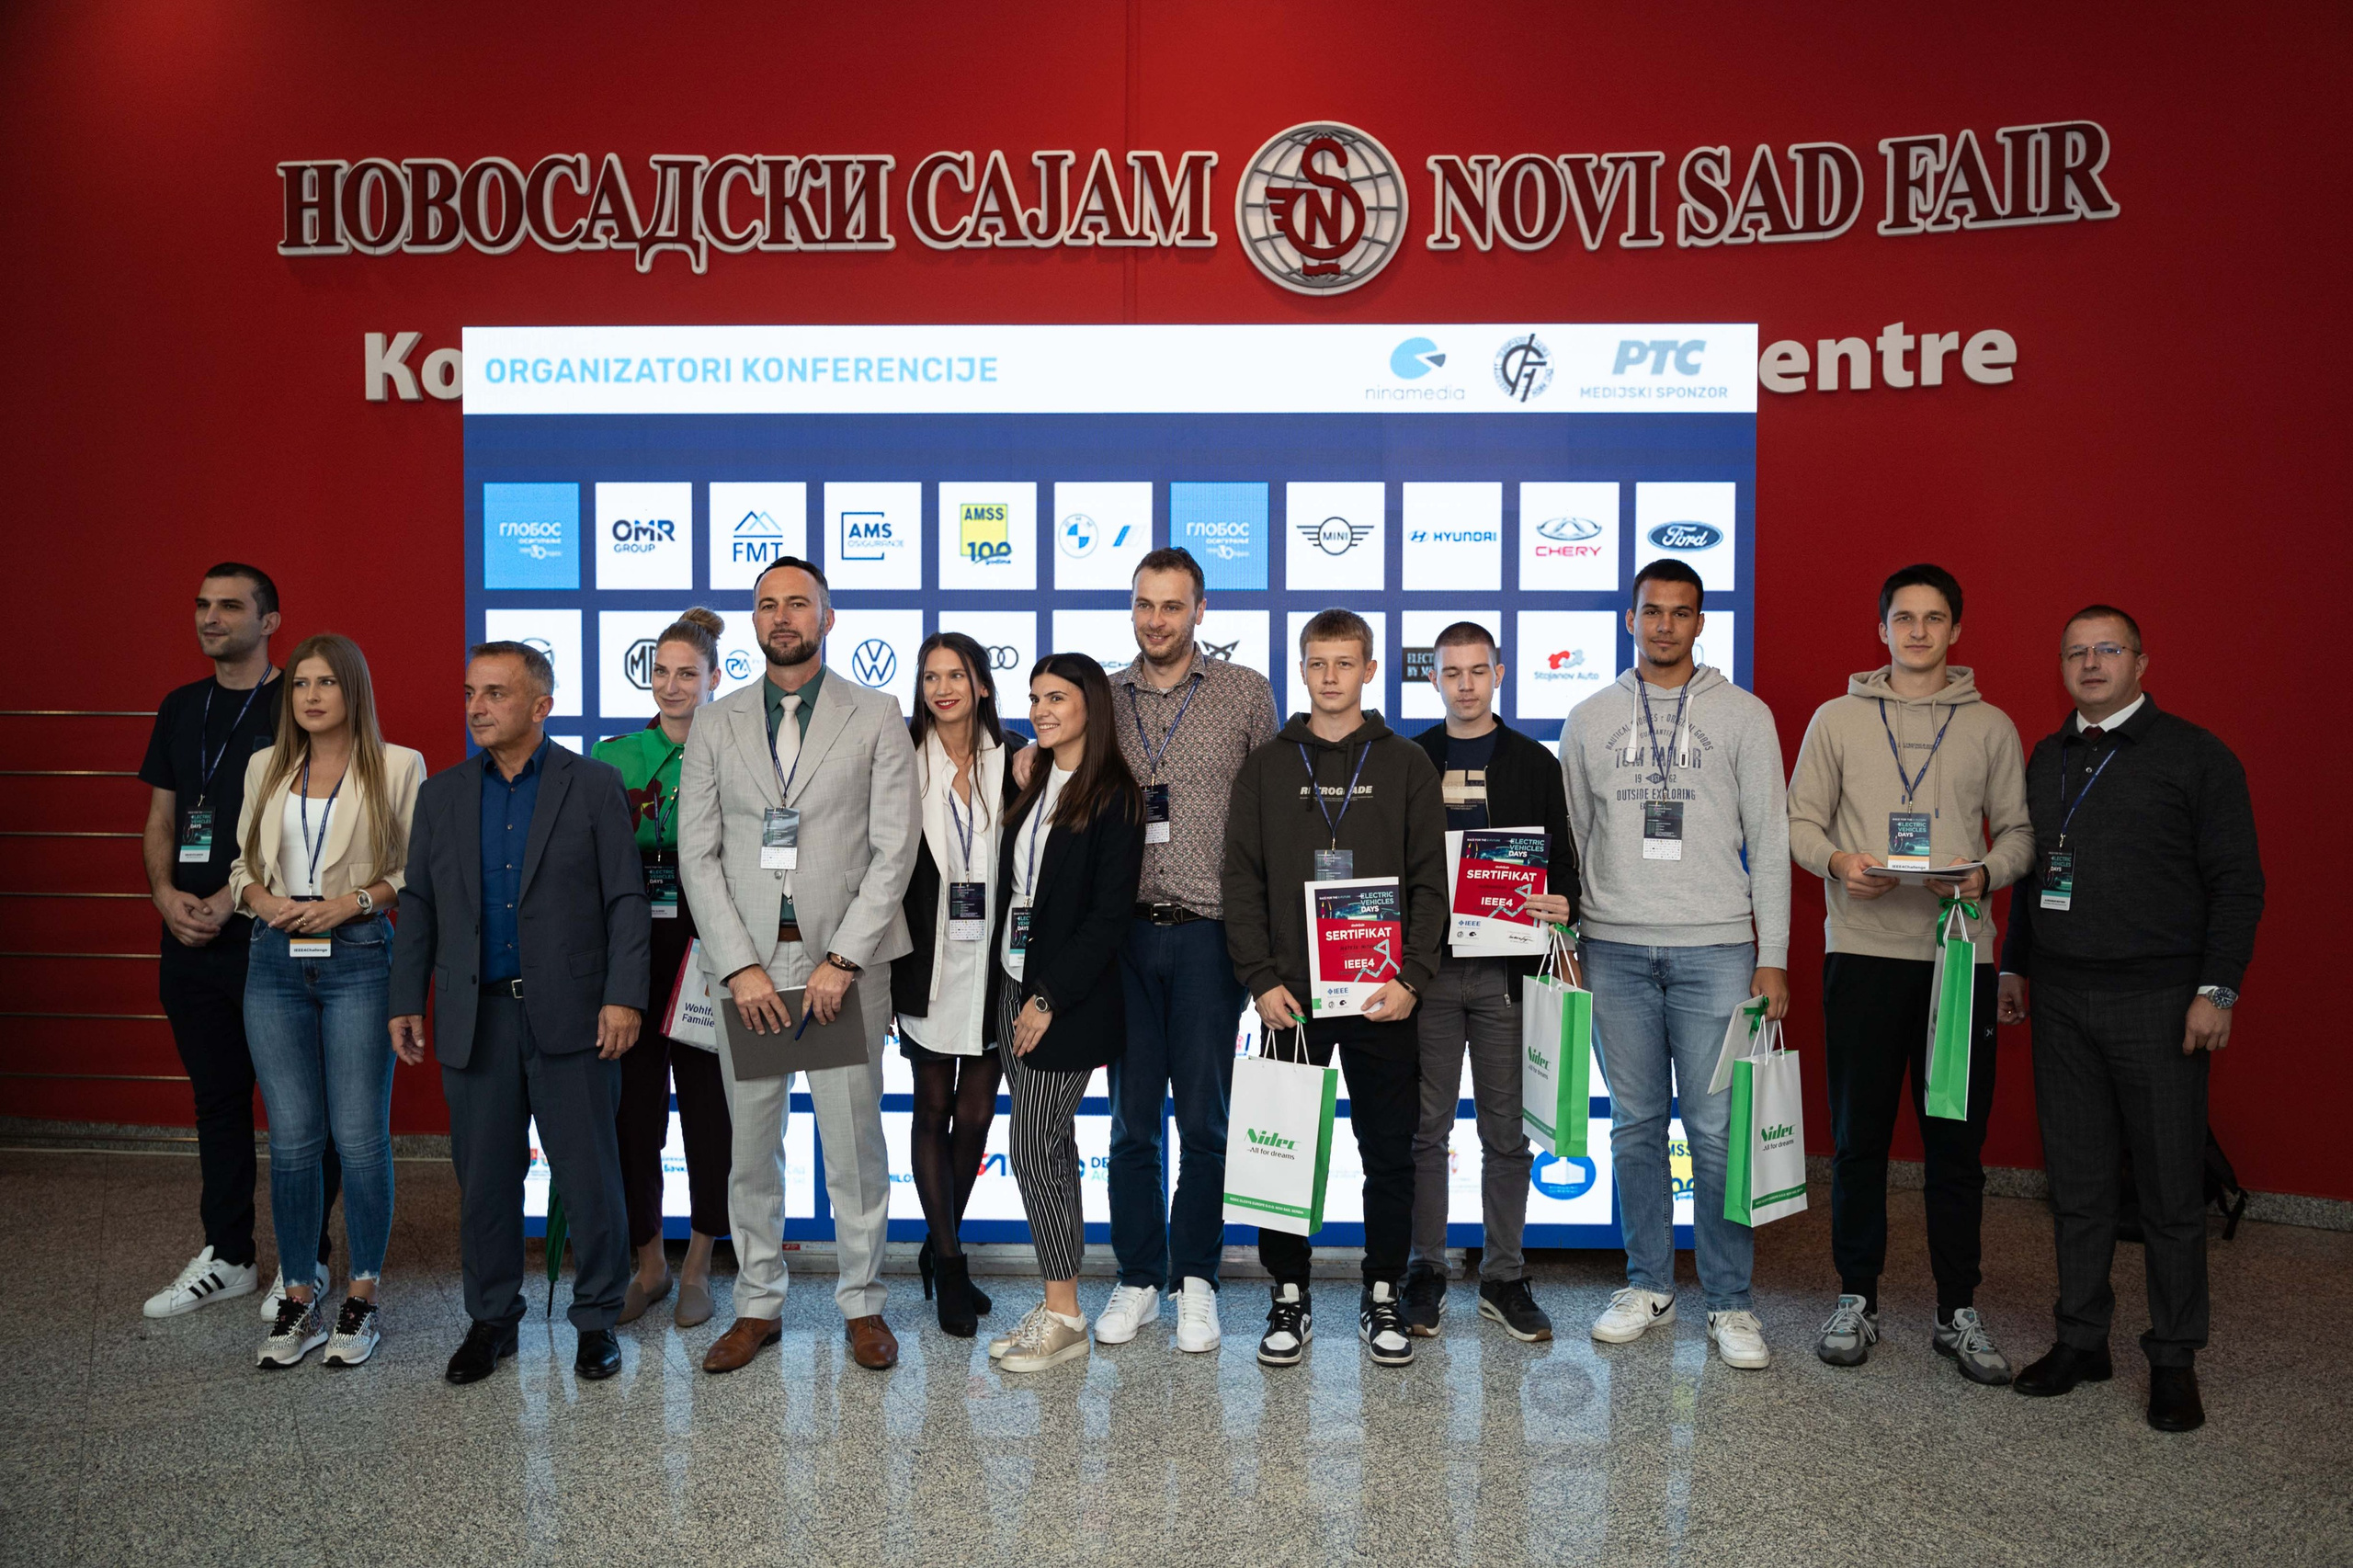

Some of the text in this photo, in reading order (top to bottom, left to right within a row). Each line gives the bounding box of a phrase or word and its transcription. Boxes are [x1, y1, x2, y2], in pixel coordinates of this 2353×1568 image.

[1427, 119, 2120, 251] NOVI SAD FAIR
[277, 148, 1218, 275] НОВОСАДСКИ САЈАМ
[485, 357, 998, 384] ORGANIZATORI KONFERENCIJE
[1366, 386, 1465, 400] ninamedia
[1580, 387, 1728, 398] MEDIJSKI SPONZOR
[964, 507, 1005, 521] AMSS
[499, 522, 562, 537] ГЛОБОС
[612, 519, 676, 541] OMR
[848, 523, 892, 539] AMS
[1187, 522, 1250, 537] ГЛОБОС
[1323, 532, 1348, 540] MINI
[1433, 531, 1497, 542] HYUNDAI
[1662, 525, 1709, 547] Ford
[613, 543, 656, 553] GROUP
[733, 542, 783, 562] FMT
[967, 541, 1012, 562] 100
[1536, 546, 1602, 557] CHERY
[1534, 671, 1599, 682] Stojanov Auto
[1694, 729, 1714, 752] GOODS
[1617, 789, 1696, 801] OUTSIDE EXLORING
[1466, 869, 1537, 881] SERTIFIKAT
[1360, 892, 1394, 900] ELECTRIC
[1360, 898, 1394, 906] VEHICLES
[1481, 897, 1513, 907] IEEE4
[1325, 926, 1392, 941] SERTIFIKAT
[1344, 959, 1375, 970] IEEE4
[682, 1013, 715, 1028] Familie
[1244, 1128, 1301, 1149] Nidec
[1760, 1123, 1796, 1142] Nidec
[1260, 1147, 1269, 1156] for
[1270, 1150, 1295, 1161] dreams
